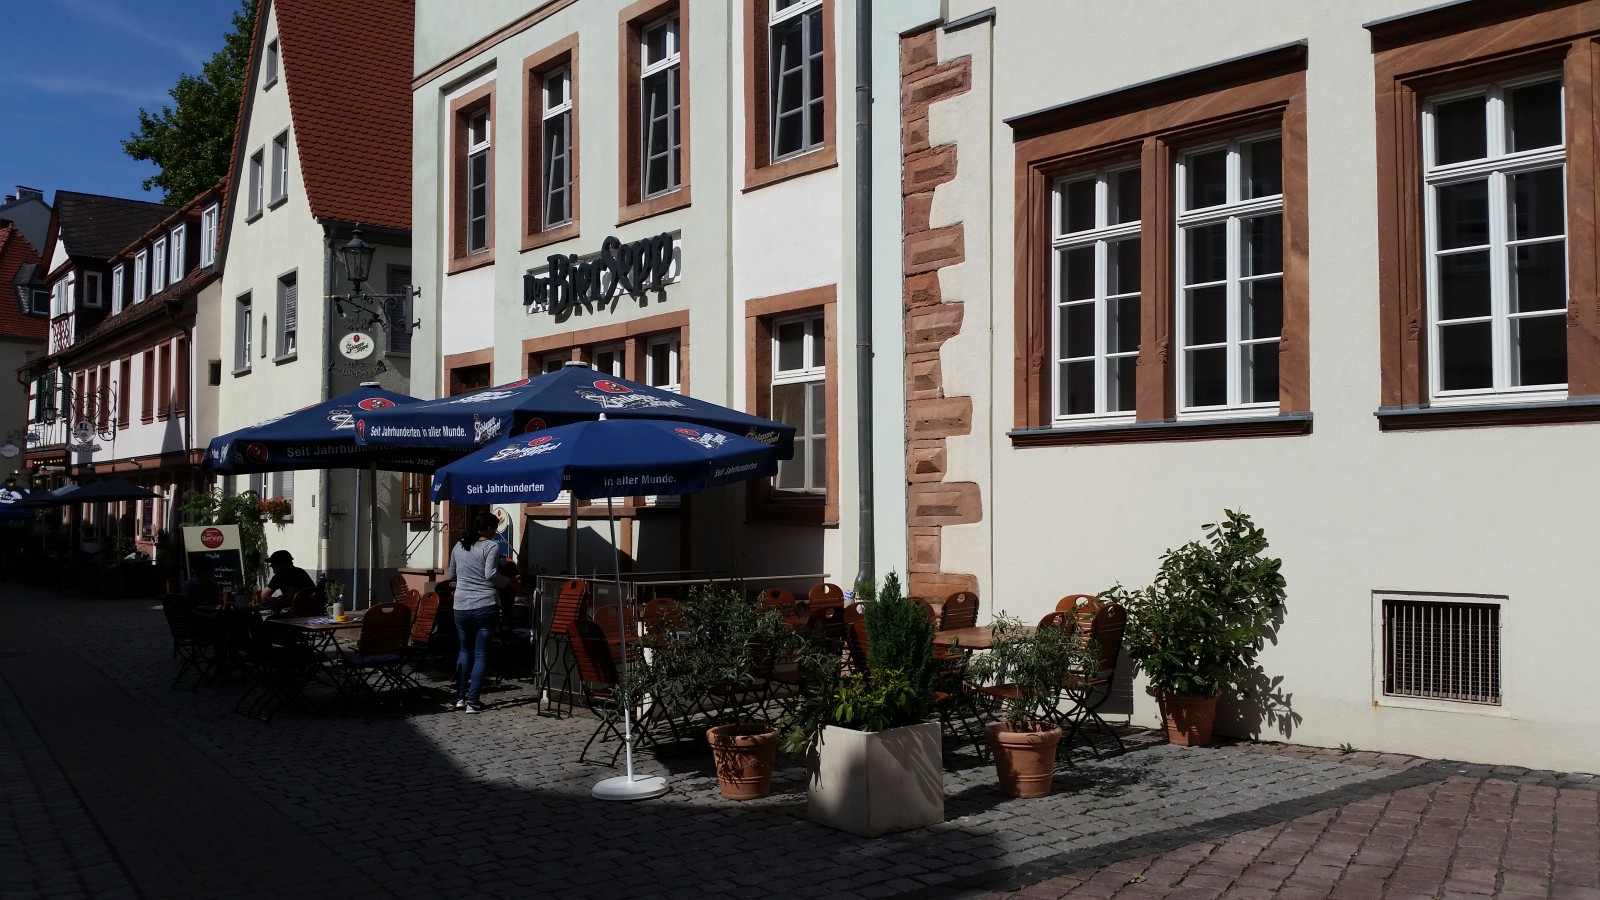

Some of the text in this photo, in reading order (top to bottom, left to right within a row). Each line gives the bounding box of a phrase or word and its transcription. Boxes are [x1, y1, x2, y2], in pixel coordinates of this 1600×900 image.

[371, 426, 381, 437] Seit
[382, 426, 421, 437] Jahrhunderten
[428, 426, 441, 437] aller
[442, 425, 467, 437] Munde.
[286, 446, 310, 457] Seit
[616, 475, 639, 486] aller
[641, 474, 677, 485] Munde.
[466, 482, 545, 495] Seit Jahrhunderten
